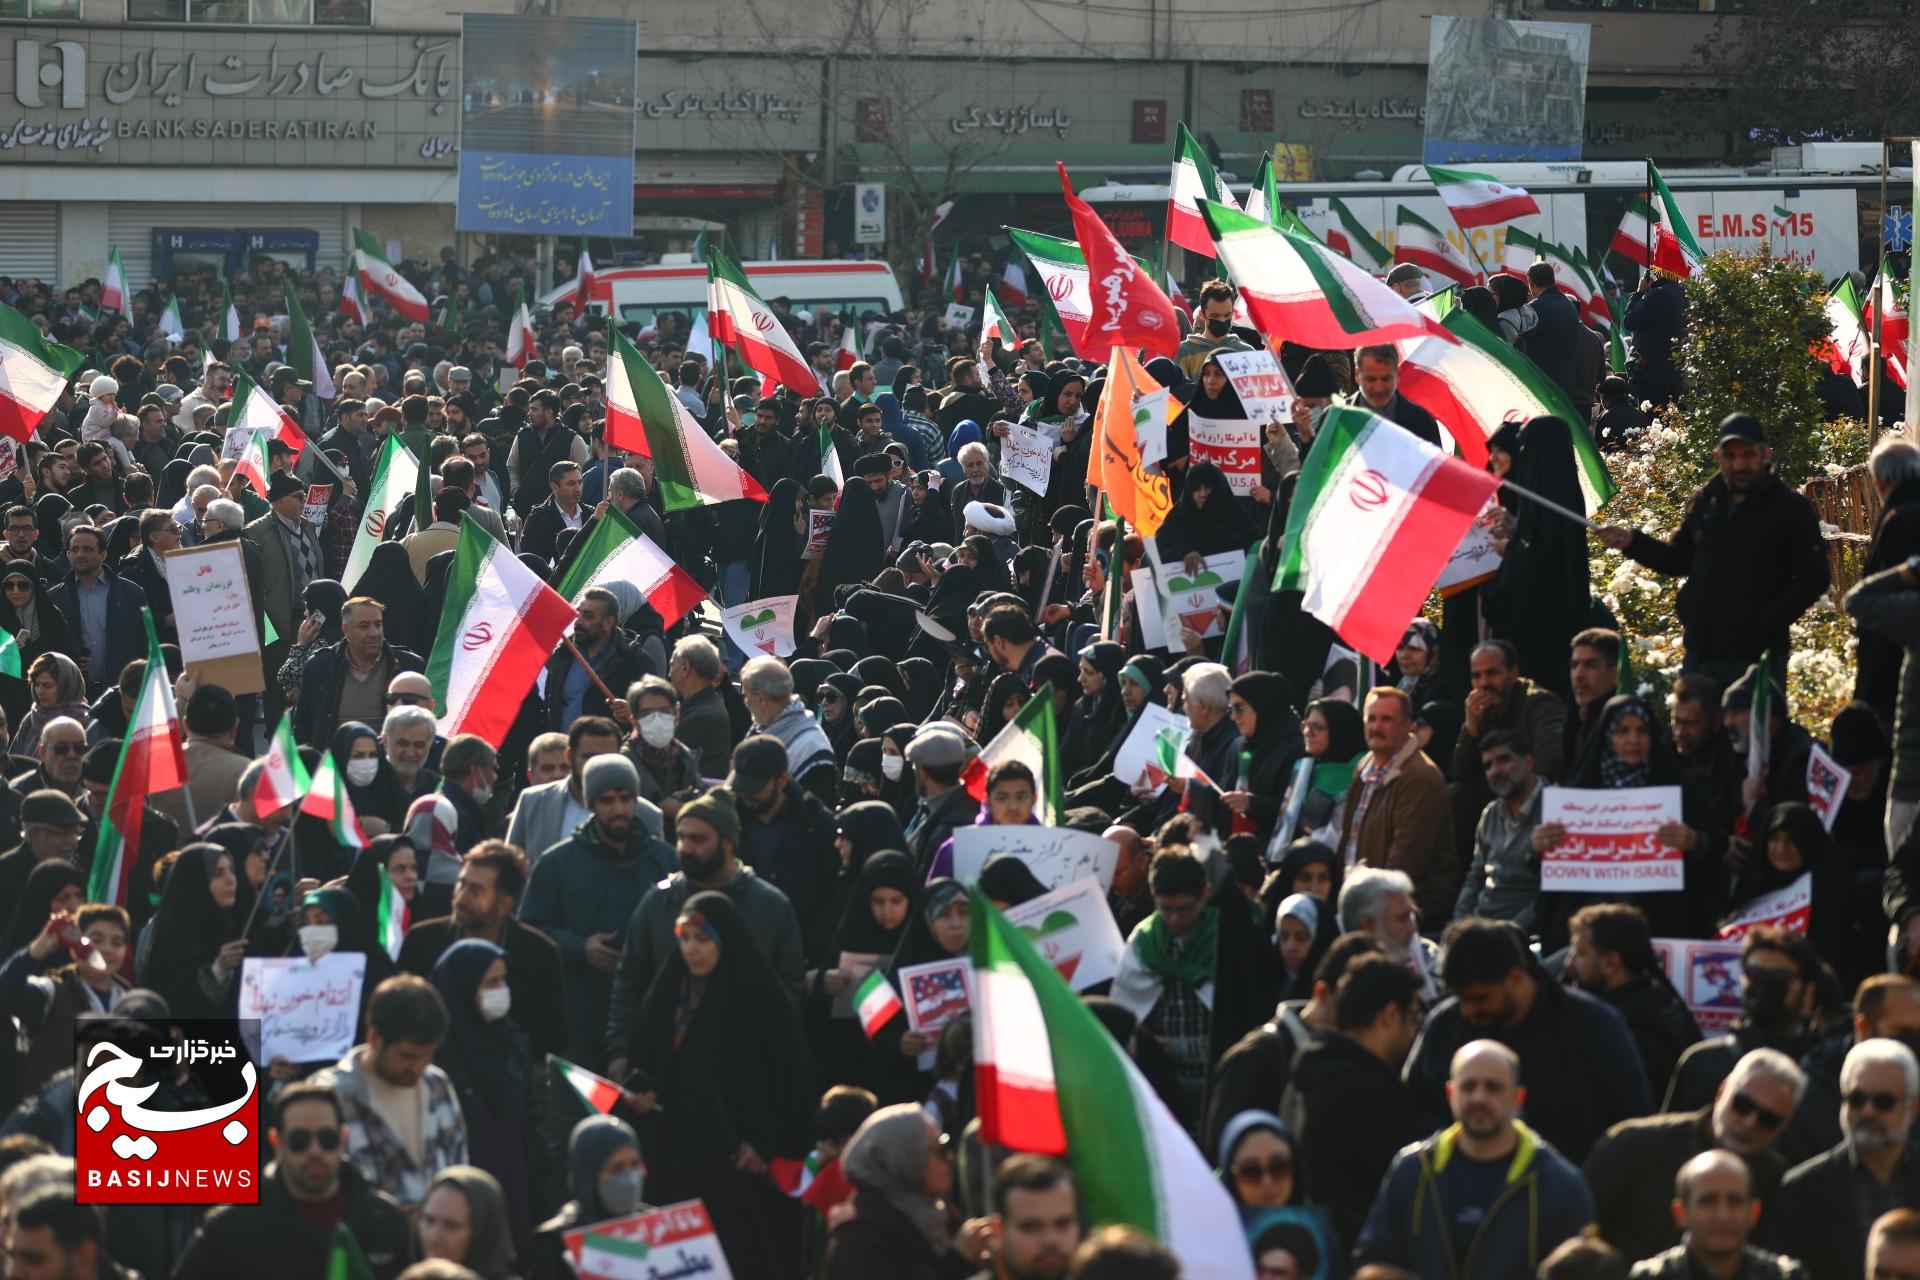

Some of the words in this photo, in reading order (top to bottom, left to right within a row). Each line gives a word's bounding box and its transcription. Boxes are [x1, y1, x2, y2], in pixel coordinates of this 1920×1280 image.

[105, 47, 197, 107] ایران
[204, 44, 353, 96] صادرات
[360, 36, 452, 116] بانک
[647, 92, 699, 119] ترکی
[117, 120, 186, 139] BANK
[952, 108, 1015, 134] زندگی
[1017, 106, 1070, 138] پاساژ
[1698, 213, 1767, 238] E.M.S
[1223, 449, 1256, 470] مرگ
[1543, 865, 1590, 879] DOWN
[1594, 866, 1630, 880] WITH
[1633, 864, 1678, 879] ISRAEL
